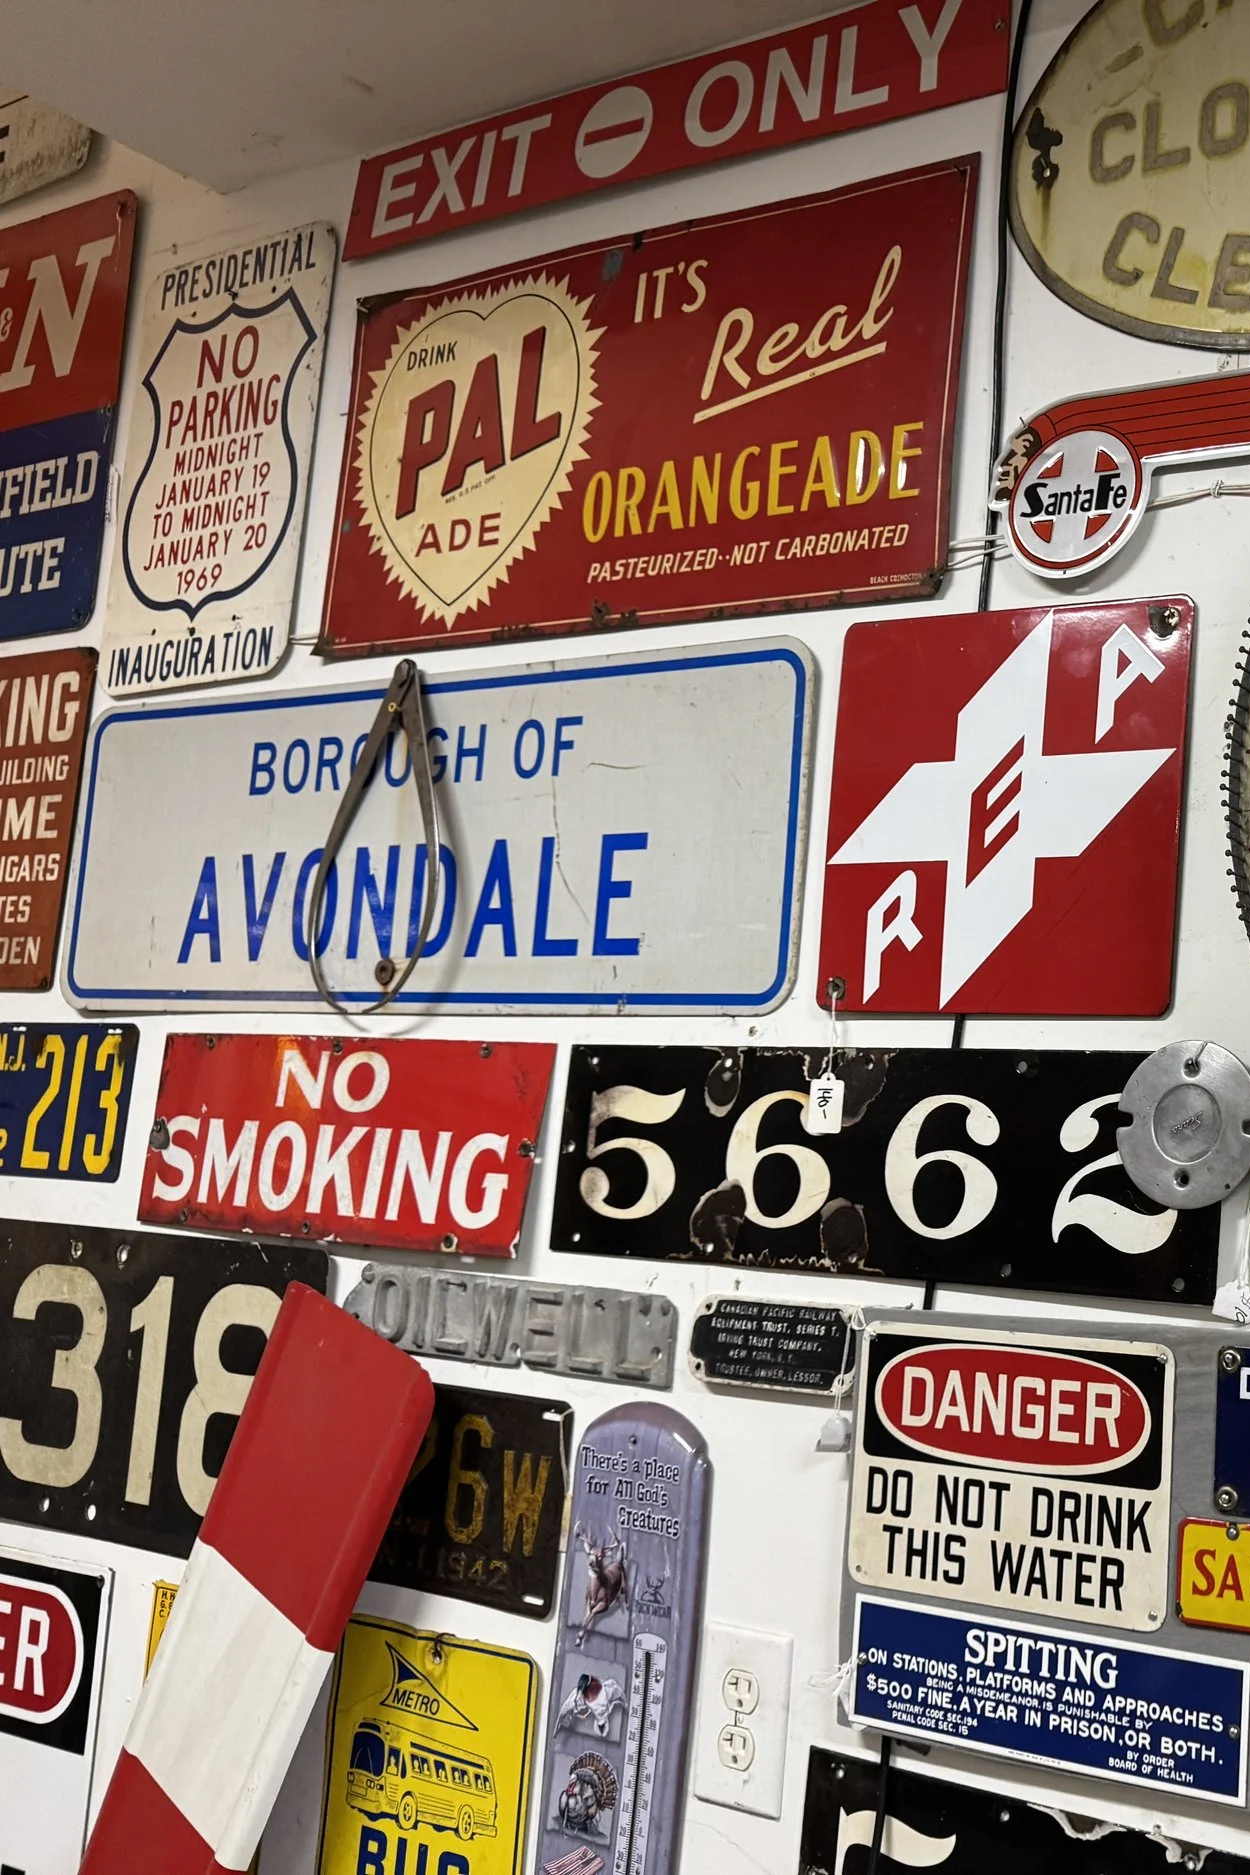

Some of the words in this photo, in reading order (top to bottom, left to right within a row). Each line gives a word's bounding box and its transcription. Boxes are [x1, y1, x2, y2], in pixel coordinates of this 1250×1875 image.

[371, 114, 552, 239] EXIT
[683, 0, 963, 148] ONLY
[161, 231, 316, 311] PRESIDENTIAL
[634, 259, 709, 324] IT'S
[700, 245, 902, 401] Real
[197, 325, 260, 388] NO
[407, 340, 458, 371] DRINK
[166, 374, 281, 449] PARKING
[395, 325, 563, 521] PAL
[0, 450, 100, 520] FIELD
[156, 467, 244, 510] JANUARY
[252, 461, 271, 488] 19
[174, 432, 264, 477] MIDNIGHT
[582, 421, 924, 543] ORANGEADE
[152, 513, 174, 540] TO
[182, 491, 270, 533] MIDNIGHT
[415, 512, 502, 557] ADE
[775, 524, 909, 562] CARBONATED
[143, 529, 235, 572] JANUARY
[243, 522, 267, 552] 20
[177, 563, 223, 596] 1969
[108, 626, 274, 688] INAUGURATION
[0, 671, 81, 747] ING
[514, 716, 583, 780] OF
[0, 794, 62, 841] ME
[177, 832, 649, 964] AVONDALE
[20, 1034, 125, 1175] 213
[275, 1050, 390, 1113] NO
[152, 1114, 510, 1230] SMOKING
[579, 1084, 1178, 1255] 5662
[748, 1335, 774, 1347] TRUST
[762, 1307, 795, 1319] PACIFIC
[796, 1324, 826, 1336] SERIES
[0, 1263, 284, 1518] 318
[901, 1366, 1121, 1448] DANGER
[582, 1446, 629, 1472] There's
[632, 1459, 640, 1473] a
[644, 1459, 680, 1482] place
[586, 1475, 609, 1495] for
[637, 1483, 668, 1507] God's
[619, 1506, 680, 1538] Creatures
[866, 1465, 913, 1519] DO
[935, 1474, 1011, 1532] NOT
[1030, 1486, 1152, 1553] DRINK
[882, 1524, 966, 1585] THIS
[991, 1540, 1125, 1611] WATER
[868, 1648, 887, 1665] ON
[966, 1667, 1056, 1700] PLATFORMS
[1062, 1686, 1095, 1707] AND
[1103, 1694, 1224, 1732] APPROACHES
[964, 1628, 1119, 1690] SPITTING
[392, 1686, 441, 1717] METRO
[866, 1672, 913, 1700] $500
[959, 1696, 971, 1713] A
[973, 1698, 1018, 1723] YEAR
[1024, 1711, 1042, 1728] IN
[1125, 1730, 1151, 1750] OR
[887, 1700, 923, 1716] SANITARY
[925, 1706, 945, 1720] CODE
[892, 1710, 916, 1724] PENAL
[916, 1714, 936, 1729] CODE
[938, 1718, 956, 1733] SEC.
[926, 1678, 954, 1691] BEING
[957, 1683, 964, 1693] A
[1043, 1701, 1053, 1711] IS
[1058, 1703, 1130, 1727] PUNISHABLE
[1135, 1718, 1153, 1731] BY
[1108, 1757, 1137, 1772] BOARD
[1141, 1763, 1153, 1775] OF
[1157, 1768, 1194, 1784] HEALTH
[1126, 1750, 1139, 1761] BY
[1143, 1753, 1175, 1769] ORDER
